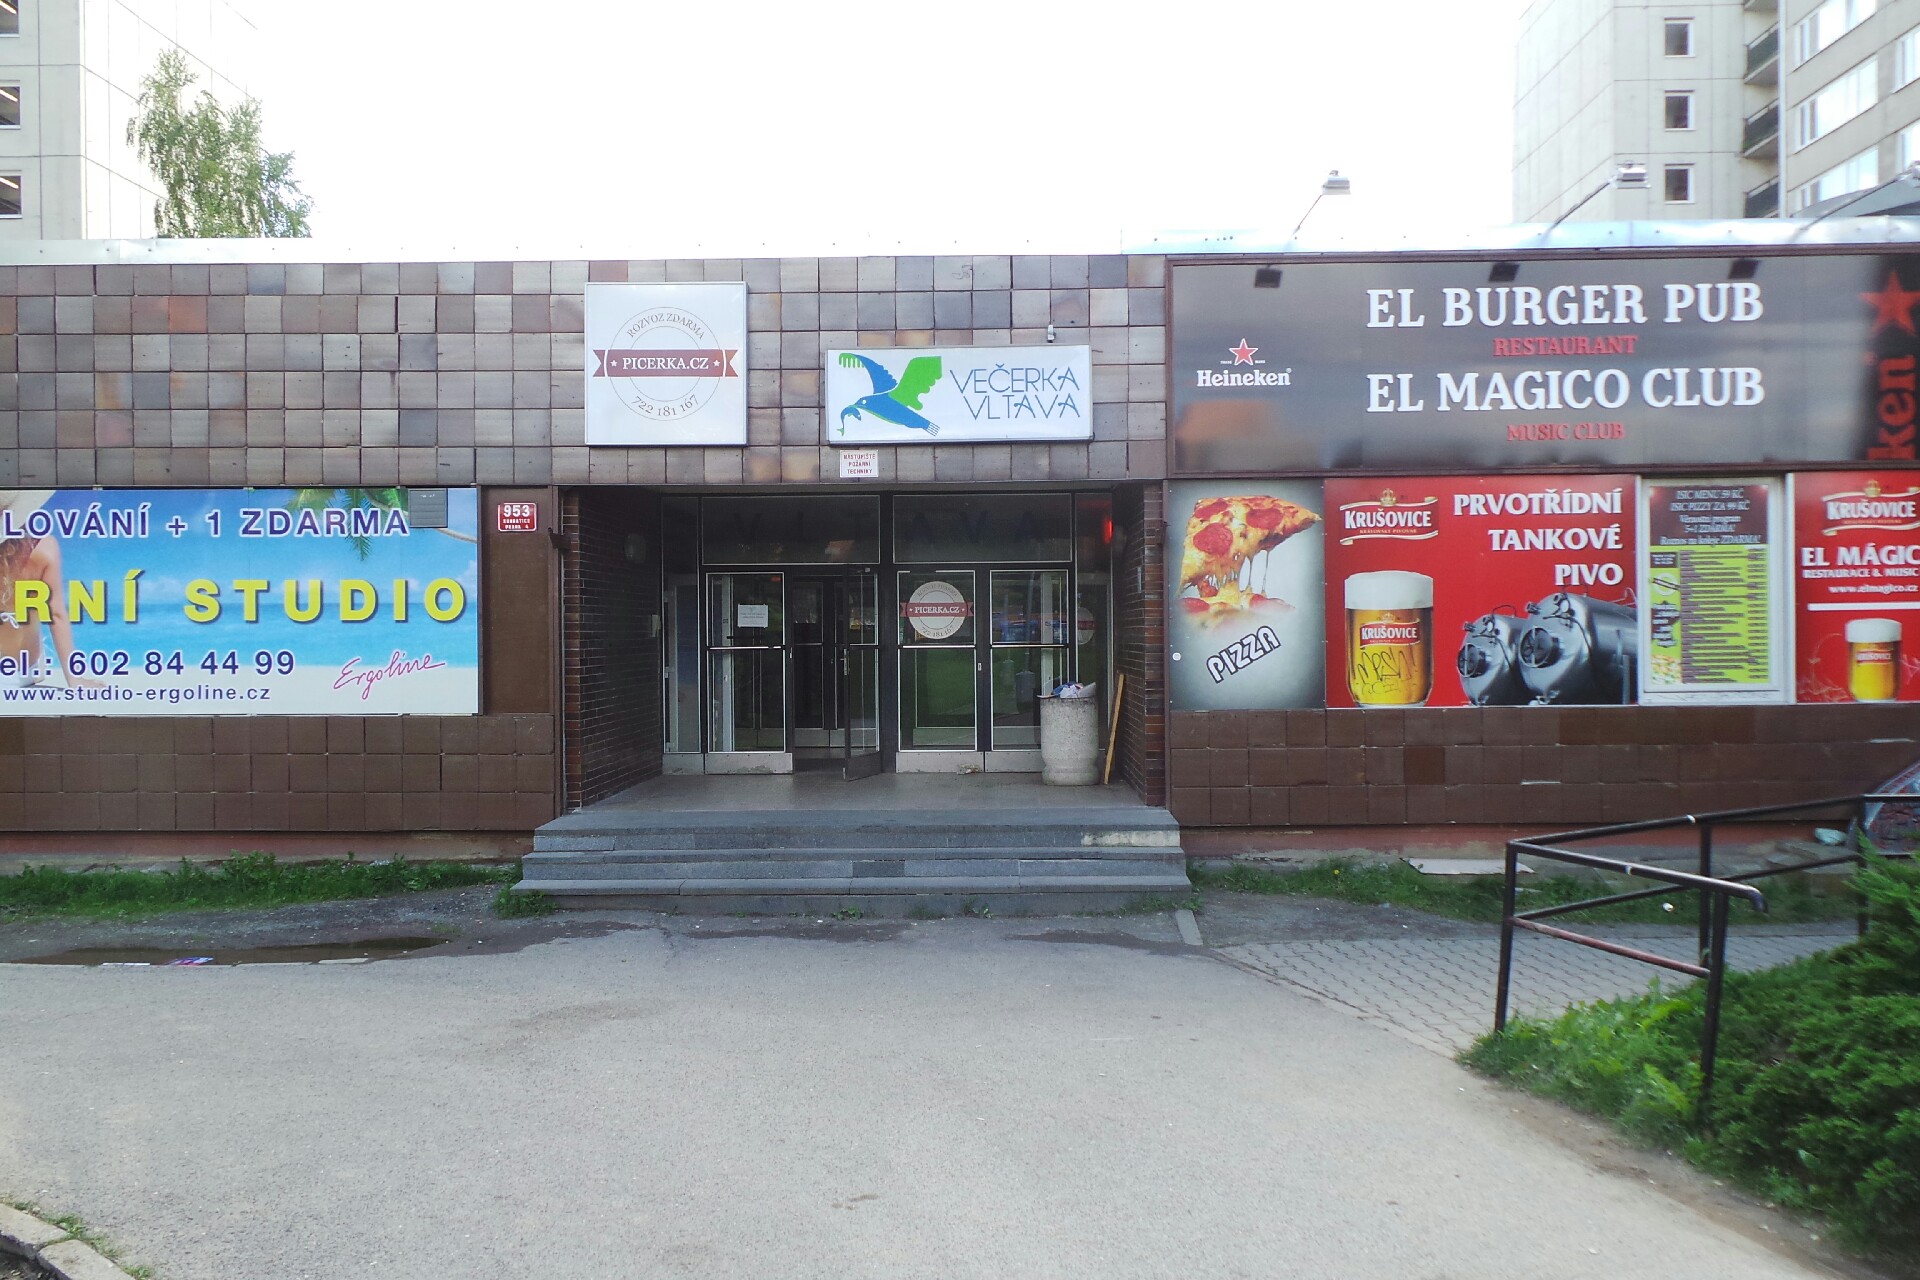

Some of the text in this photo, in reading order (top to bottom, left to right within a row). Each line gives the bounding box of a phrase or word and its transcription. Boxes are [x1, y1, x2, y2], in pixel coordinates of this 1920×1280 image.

[1366, 282, 1764, 327] EL BURGER PUB
[626, 312, 706, 340] ROZVOZ ZDARMA
[1492, 335, 1638, 356] RESTAURANT
[622, 357, 709, 370] PICERKA.CZ
[949, 363, 1080, 394] VEČERKA
[1196, 369, 1291, 387] Heineken
[1366, 367, 1765, 412] EL MAGICO CLUB
[632, 394, 699, 417] 722 181 167
[963, 393, 1080, 420] VLTAVA
[1506, 422, 1625, 441] MUSIC CLUB
[503, 504, 530, 517] 953
[1453, 488, 1623, 516] PRVOTŘÍDNÍ
[1827, 498, 1917, 520] KRUŠOVICE
[167, 516, 187, 536] +
[207, 510, 222, 536] 1
[240, 508, 409, 536] ZDARMA
[1345, 508, 1432, 529] KRUŠOVICE
[1488, 523, 1623, 550] TANKOVÉ
[1801, 547, 1830, 566] EL
[1554, 563, 1624, 586] PIVO
[1802, 567, 1919, 578] RESTAURACE & MUSIC
[15, 569, 465, 623] RNÍ STUDIO
[914, 606, 960, 614] PICERKA.CZ
[1361, 625, 1418, 639] KRUŠOVICE
[69, 651, 130, 676] 602
[144, 651, 184, 676] 84
[200, 651, 240, 676] 44
[254, 650, 295, 676] 99
[1206, 625, 1281, 684] PIZZA
[333, 651, 446, 700] Ergoline
[3, 685, 271, 704] www.studio-ergoline.cz
